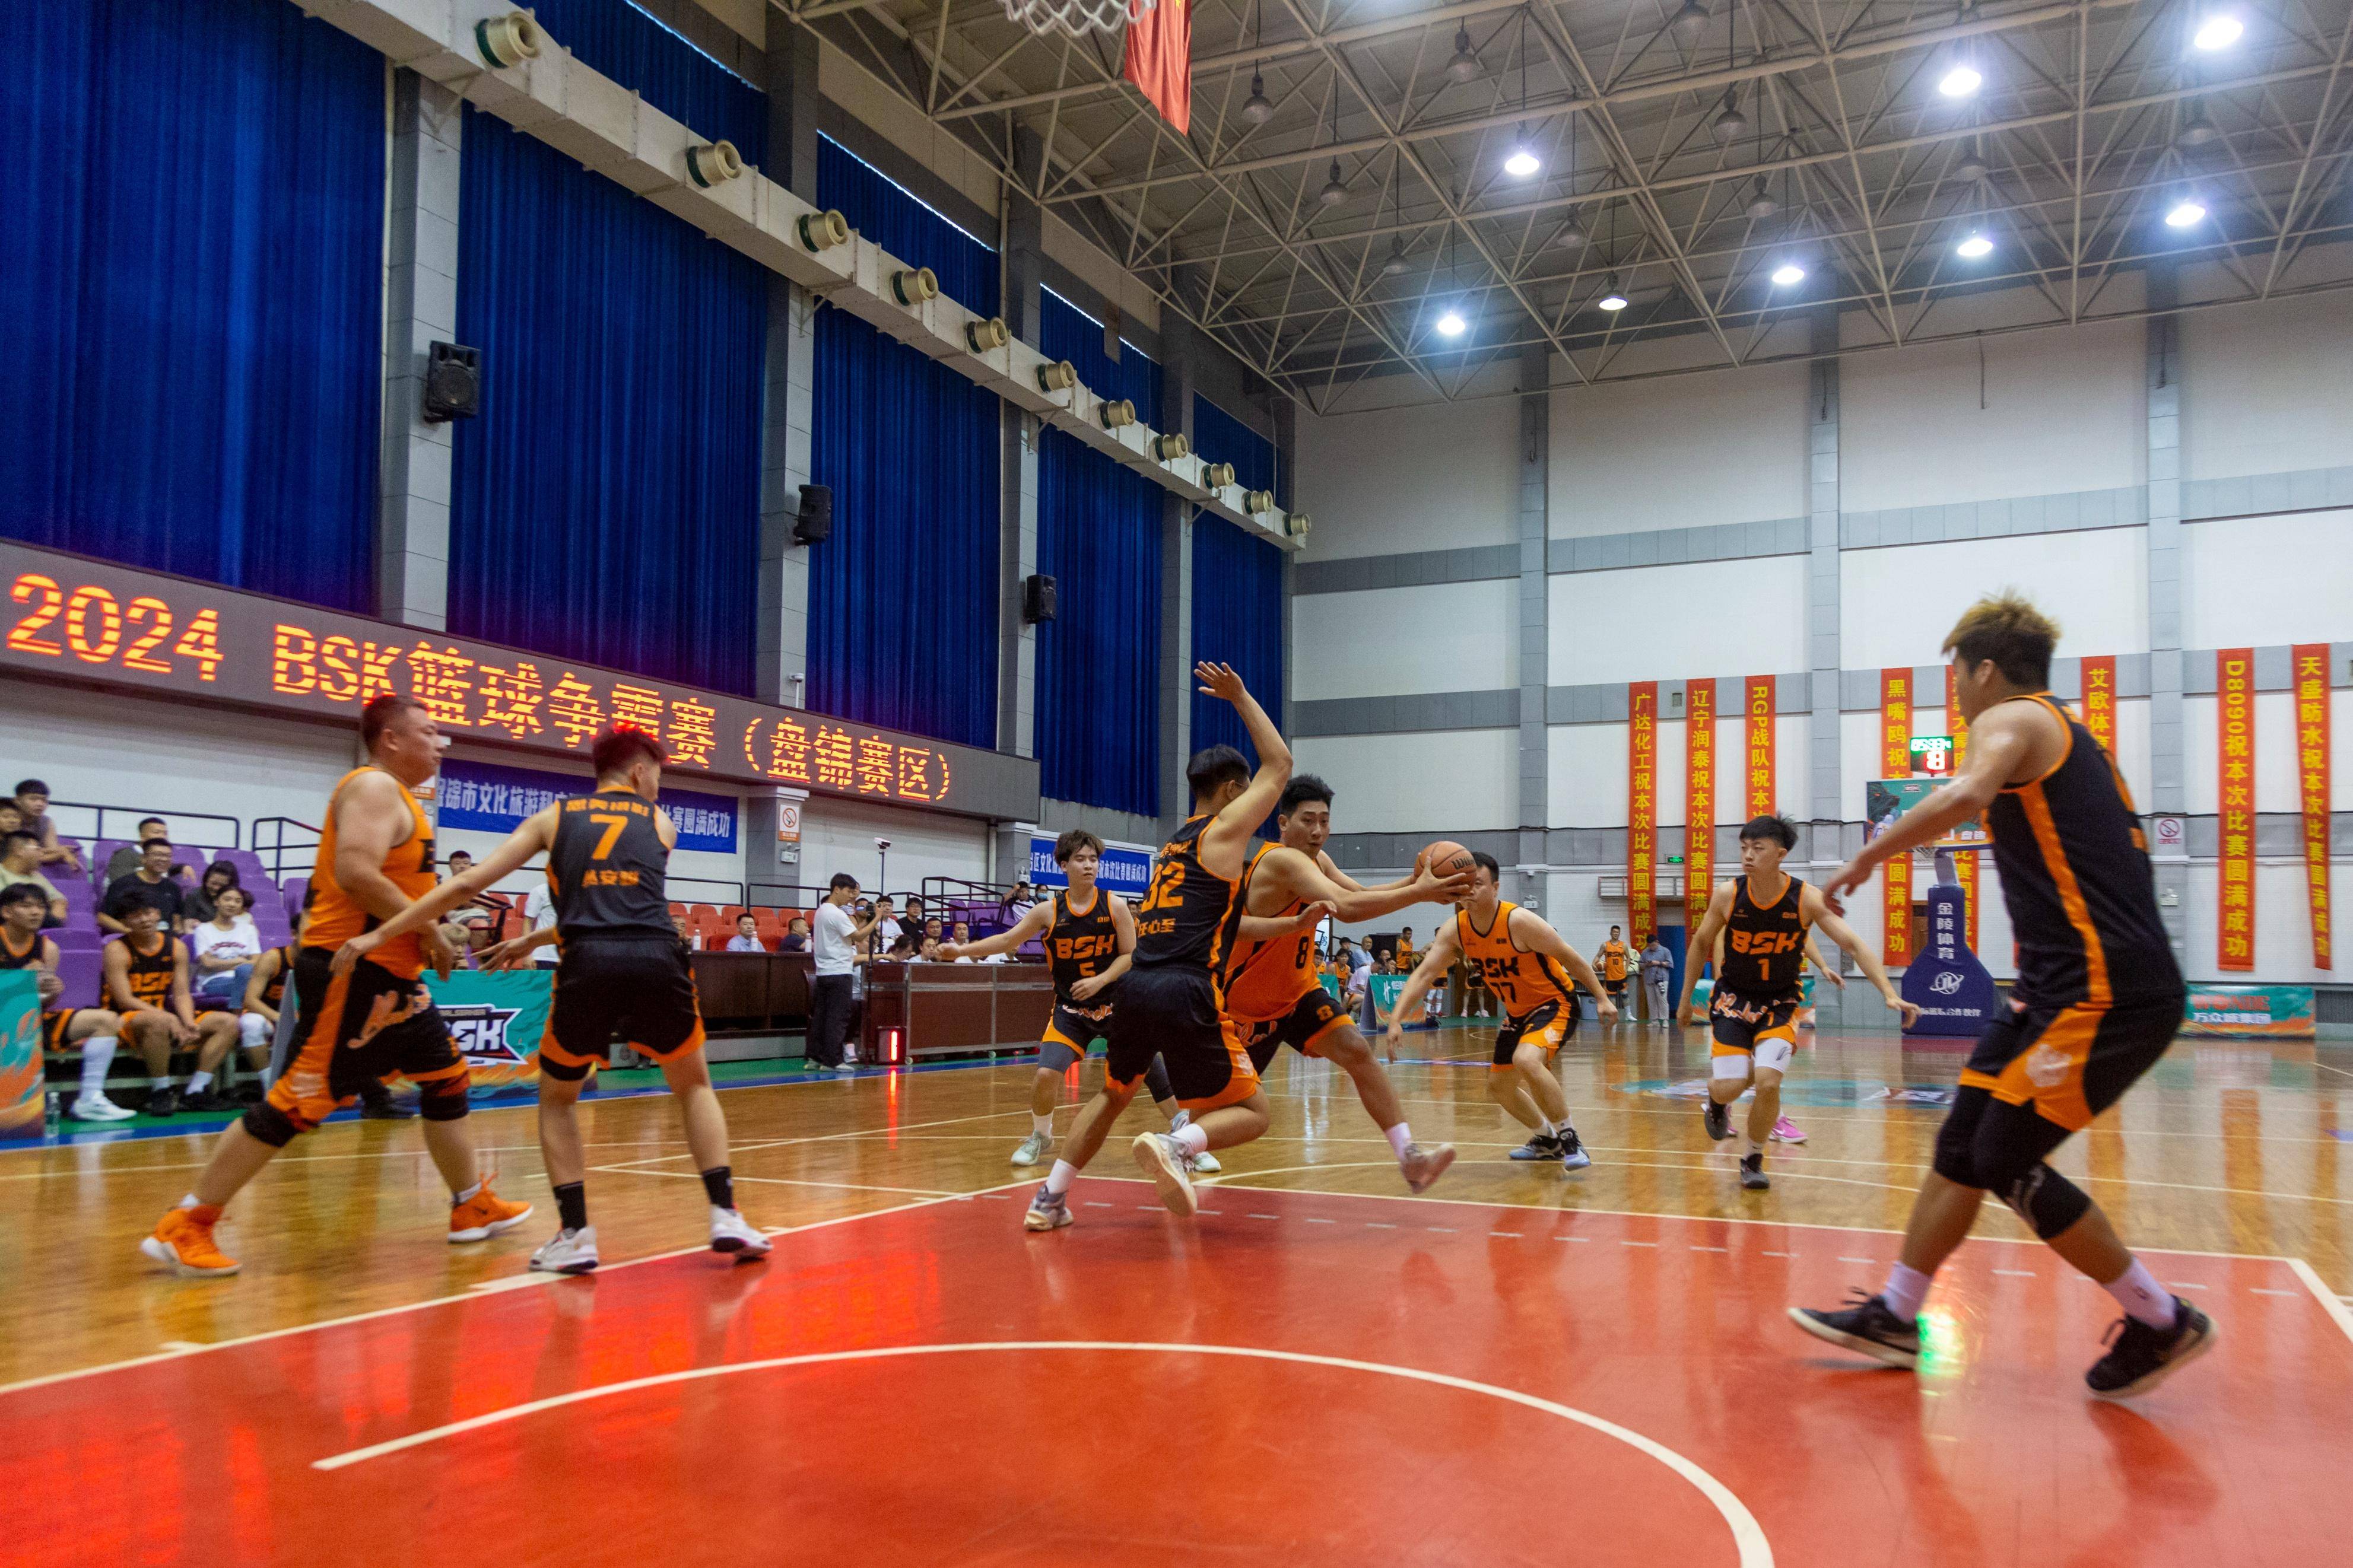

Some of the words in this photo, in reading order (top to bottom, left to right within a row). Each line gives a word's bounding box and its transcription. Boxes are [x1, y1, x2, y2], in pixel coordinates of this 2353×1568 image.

[8, 573, 224, 682] 2024
[590, 814, 628, 860] 7
[1055, 934, 1116, 959] BSK
[1730, 928, 1801, 955] BSK
[1936, 902, 1954, 960] 金陵体育
[1295, 936, 1309, 969] 8
[1758, 958, 1770, 981] 1
[444, 1019, 504, 1051] SK
